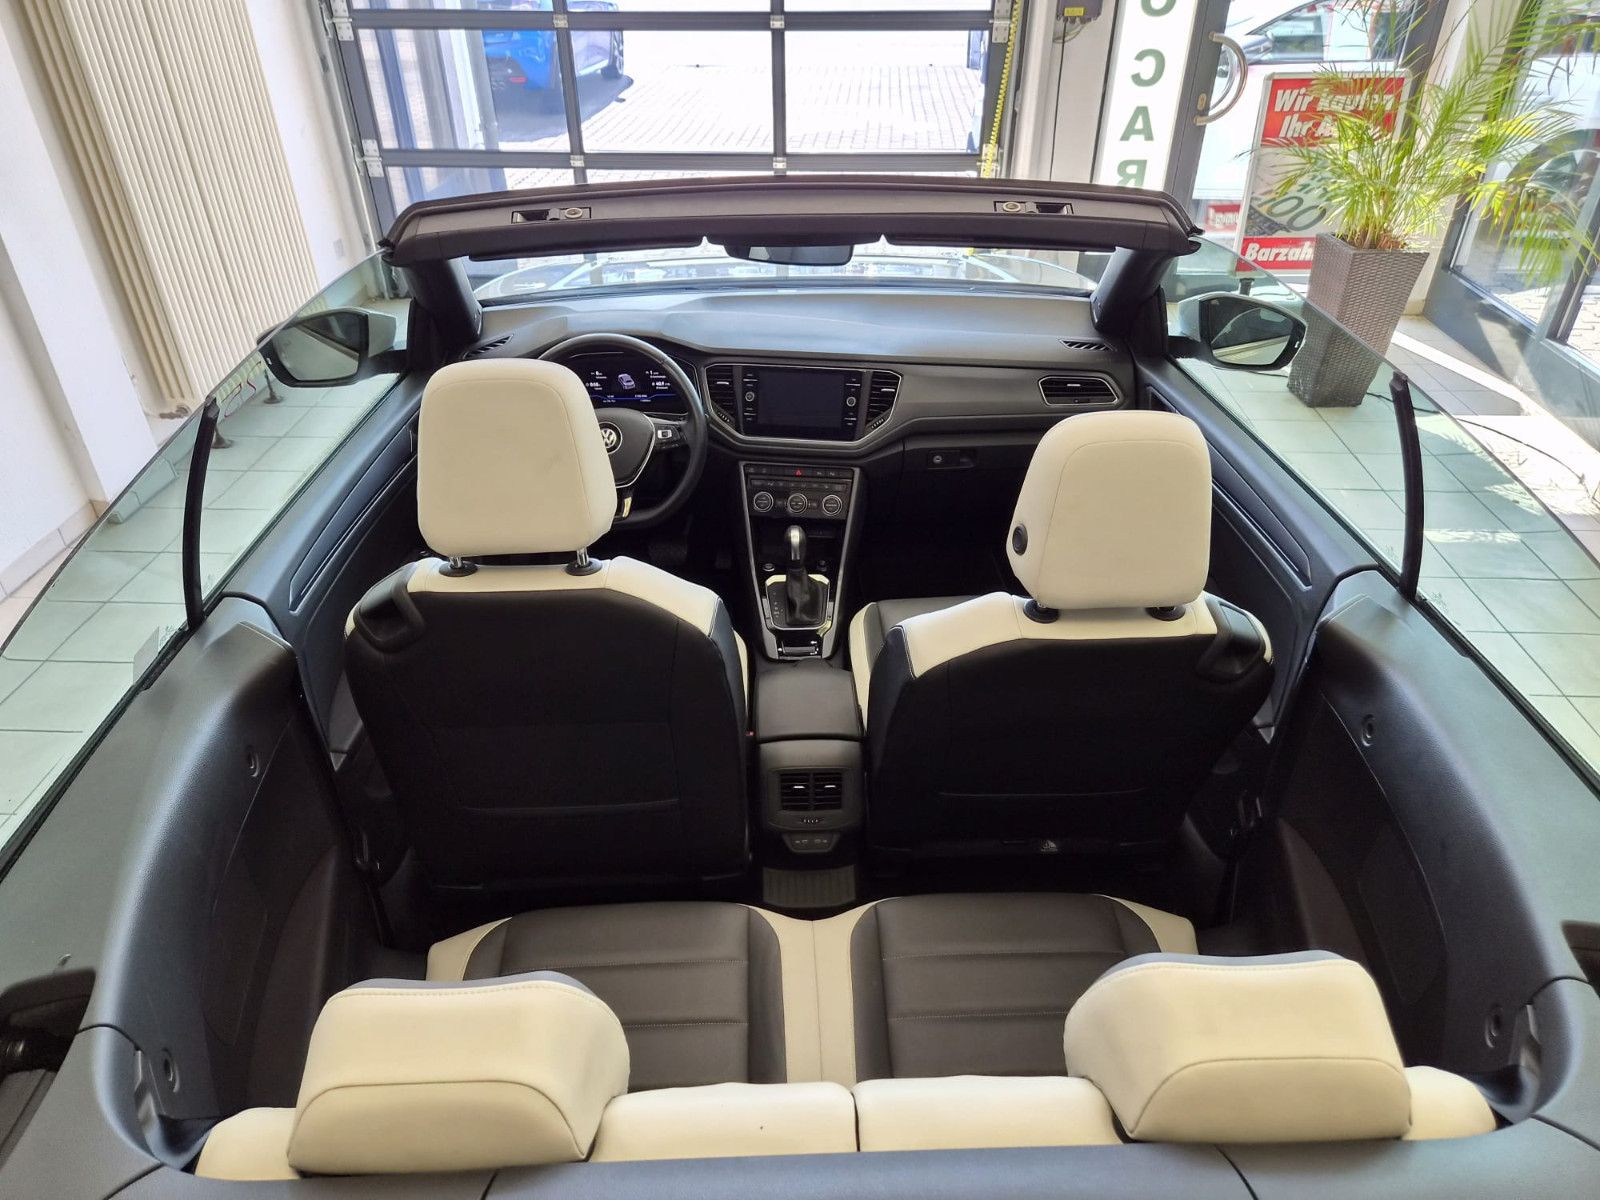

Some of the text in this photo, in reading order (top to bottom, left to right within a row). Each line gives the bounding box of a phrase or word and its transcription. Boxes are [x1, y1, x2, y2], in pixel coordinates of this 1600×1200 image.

[1274, 88, 1313, 112] Wir
[1279, 113, 1313, 138] Ihr
[1245, 241, 1314, 262] Barzah
